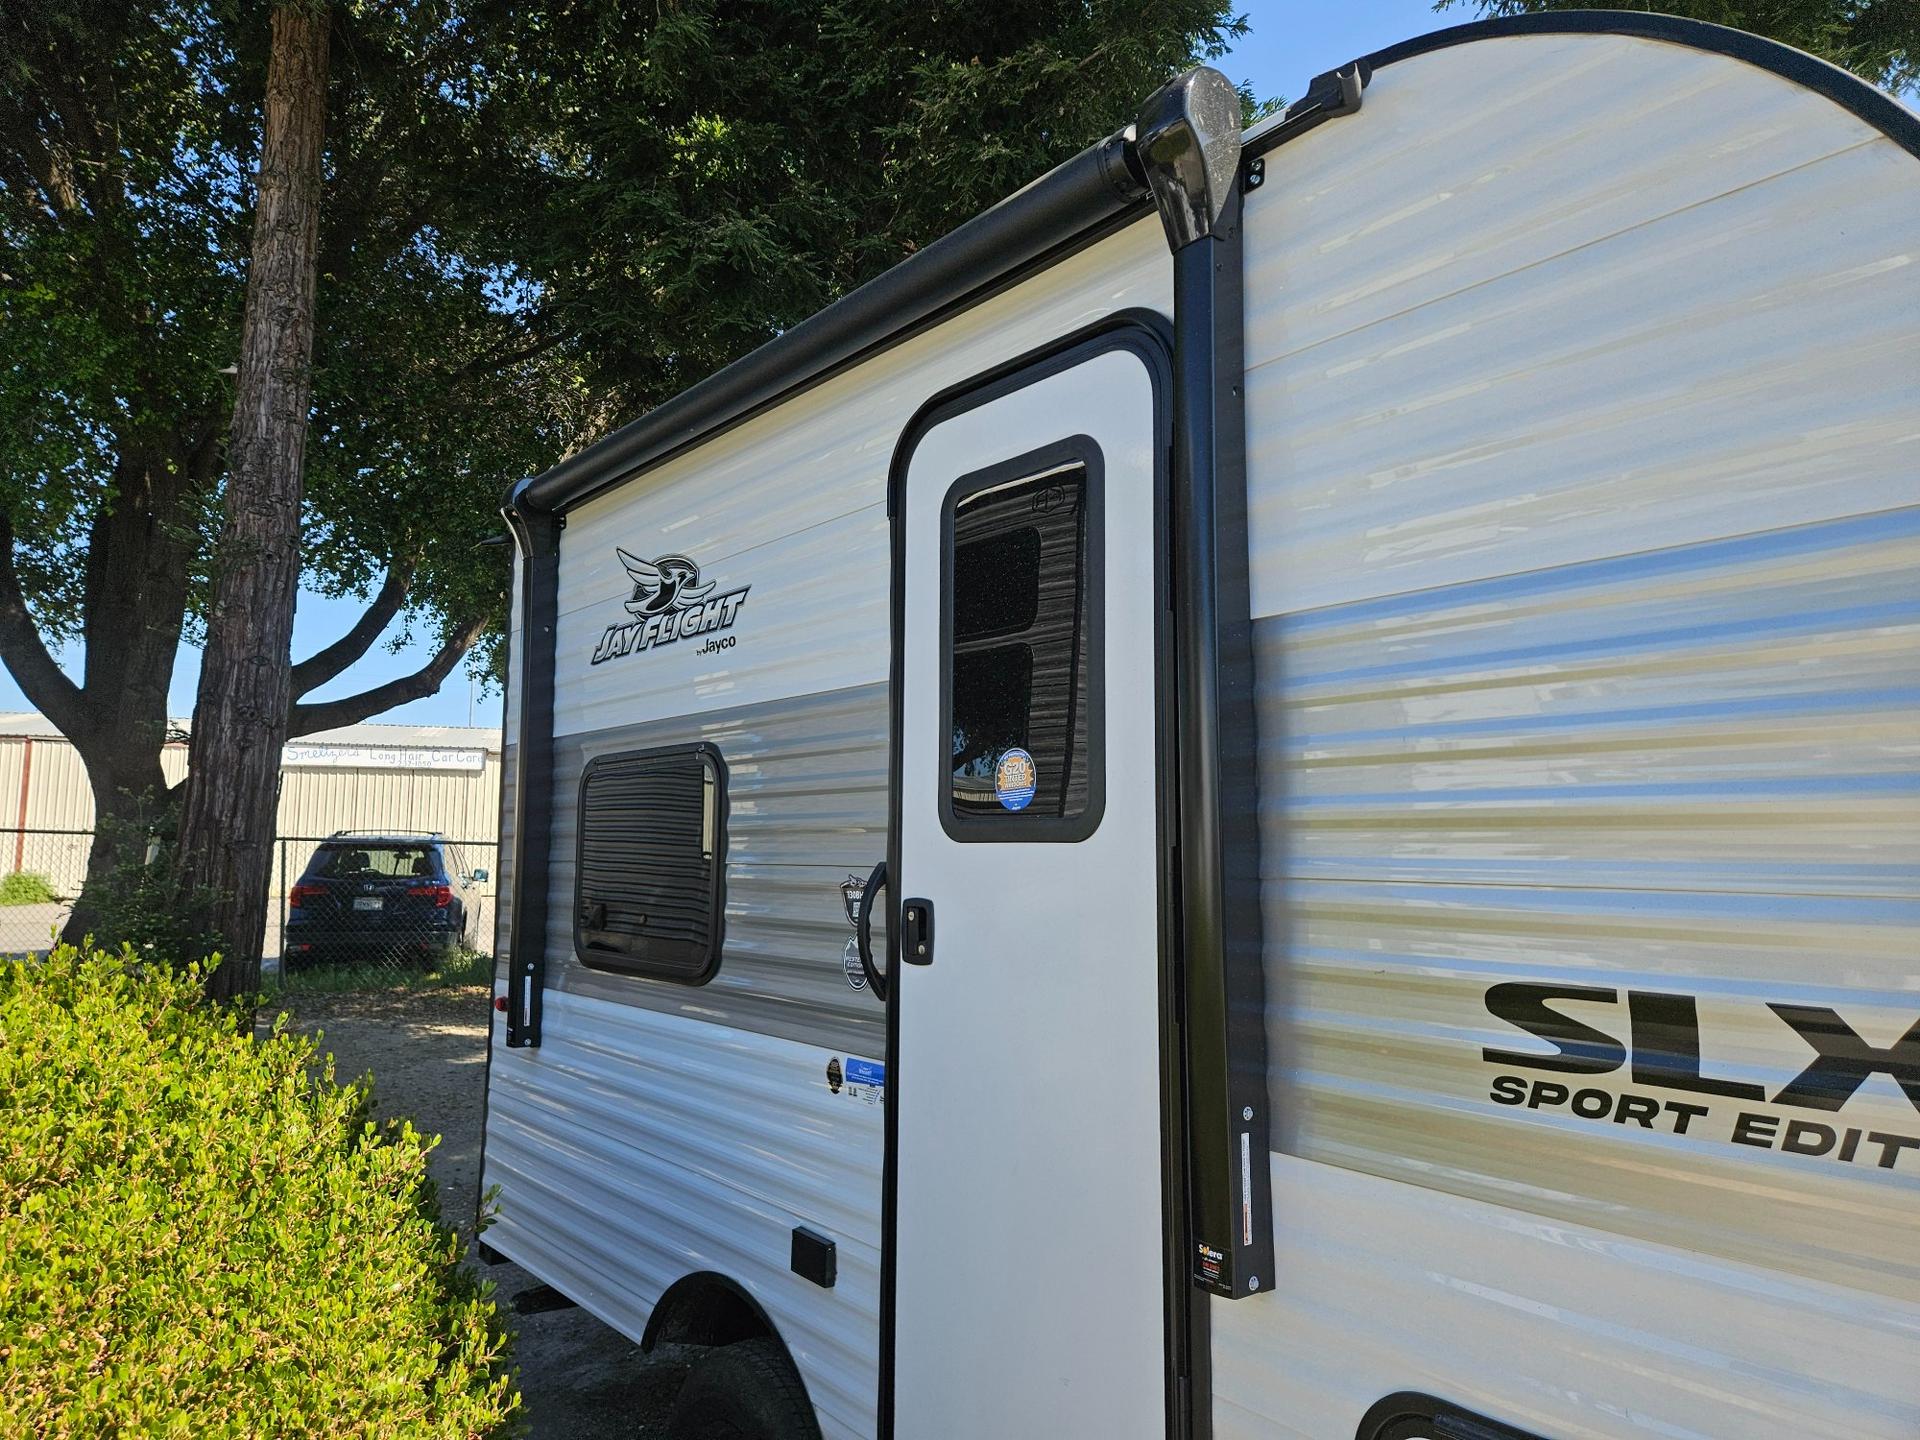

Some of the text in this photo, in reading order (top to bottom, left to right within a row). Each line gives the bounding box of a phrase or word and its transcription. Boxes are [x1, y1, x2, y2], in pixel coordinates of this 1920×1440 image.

[702, 636, 736, 654] Jayco
[370, 748, 395, 764] Long
[399, 748, 424, 761] Hair
[432, 749, 454, 762] Car
[1004, 762, 1026, 775] G20
[1482, 981, 1920, 1113] SLX
[1489, 1075, 1920, 1169] SPORT EDIT
[1198, 1243, 1223, 1260] Solera
